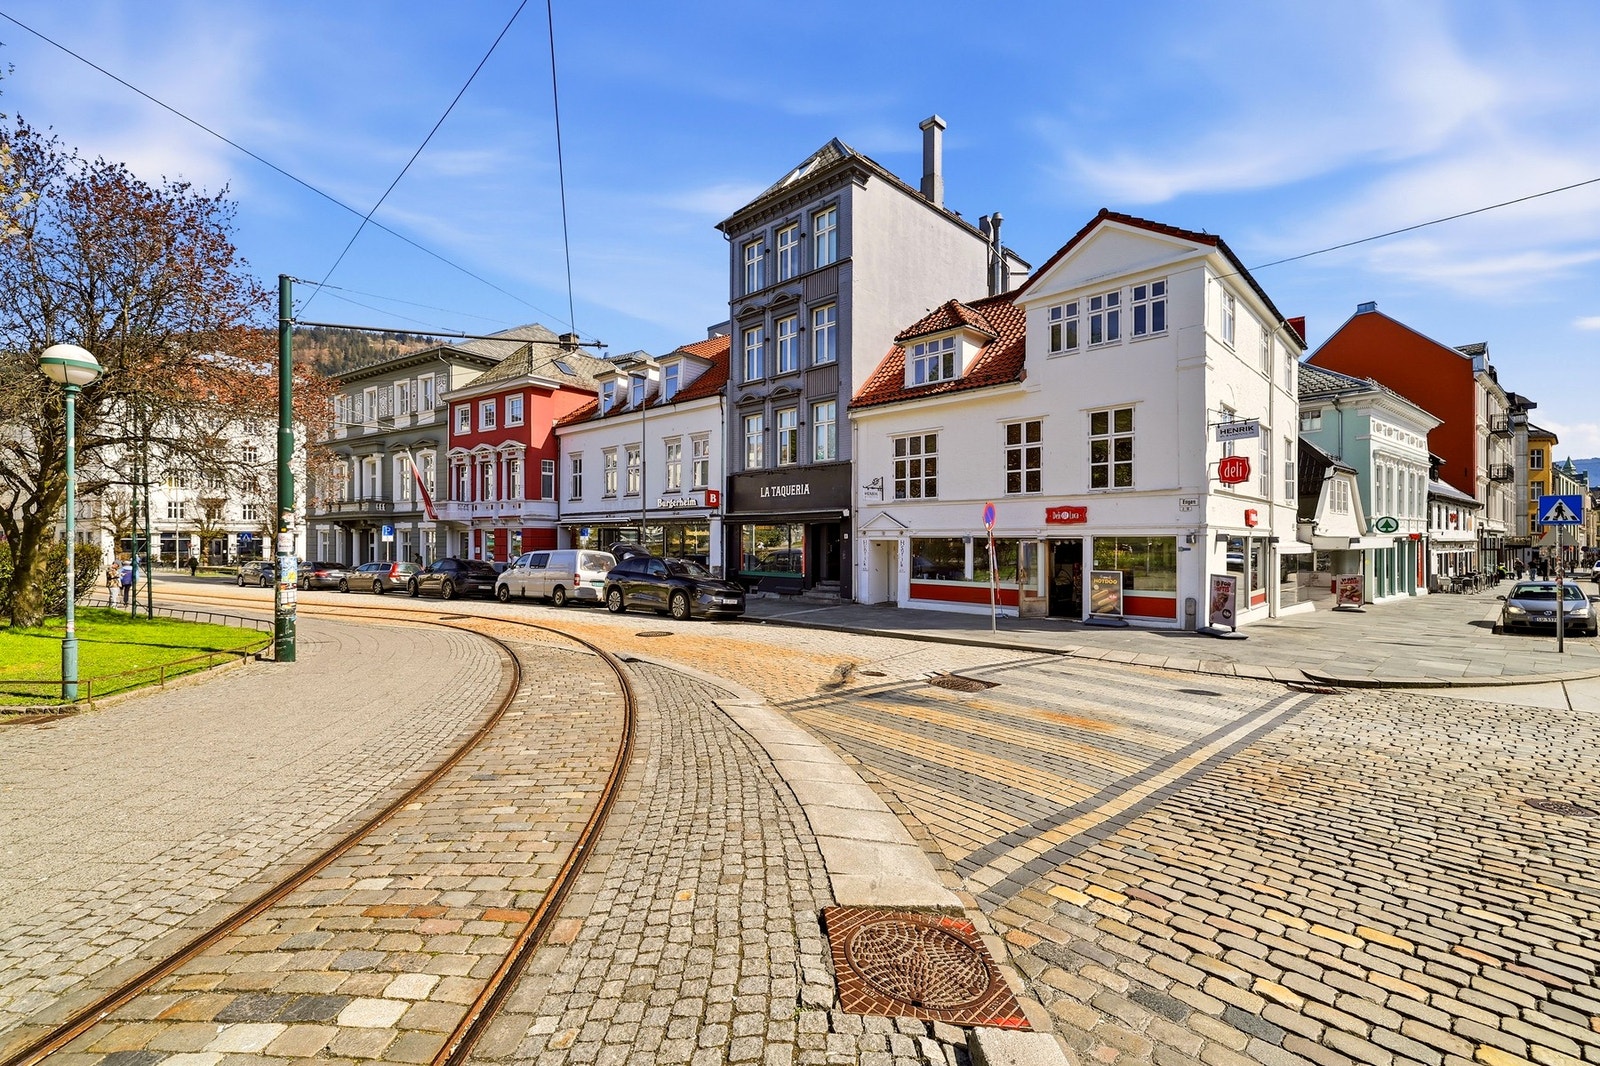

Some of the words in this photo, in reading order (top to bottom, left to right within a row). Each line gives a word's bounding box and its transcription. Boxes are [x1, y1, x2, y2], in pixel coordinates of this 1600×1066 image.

[1220, 425, 1254, 434] HENRIK
[1224, 461, 1242, 478] deli
[760, 487, 770, 498] LA
[771, 483, 810, 498] TAQUERIA
[657, 497, 698, 508] Burgerheim
[709, 493, 717, 503] B
